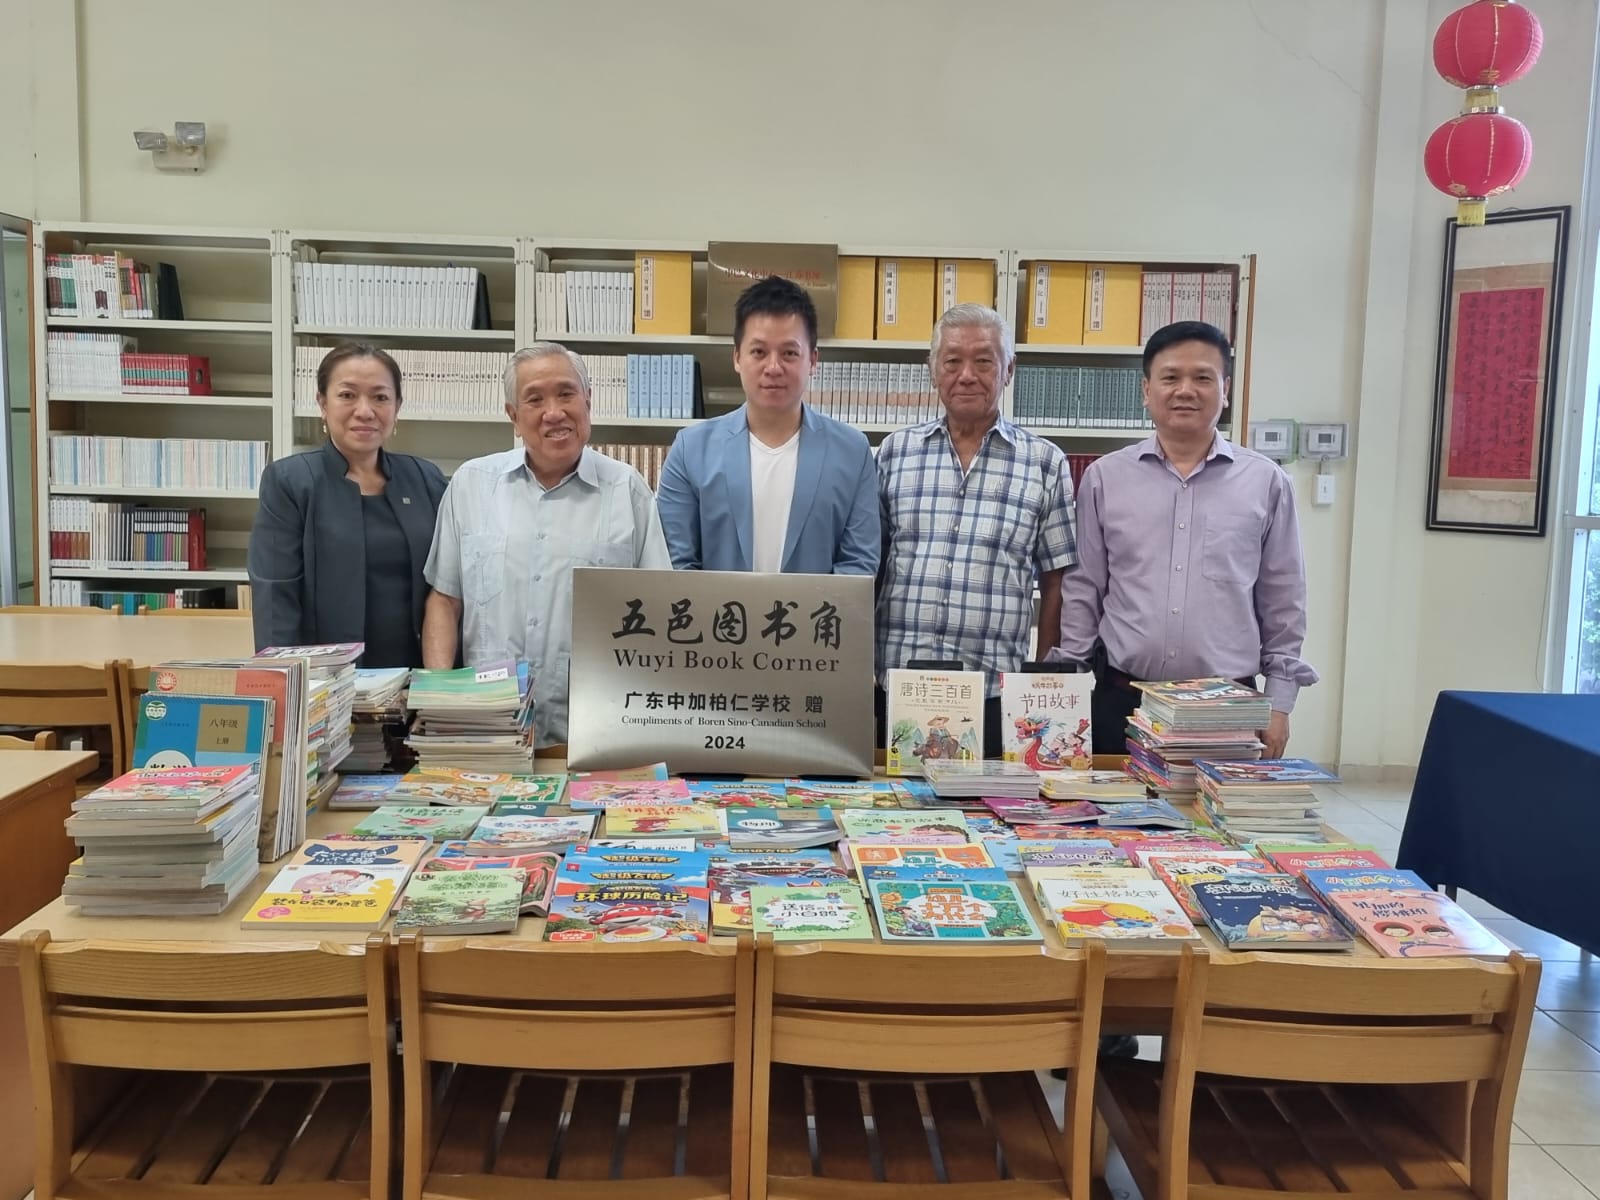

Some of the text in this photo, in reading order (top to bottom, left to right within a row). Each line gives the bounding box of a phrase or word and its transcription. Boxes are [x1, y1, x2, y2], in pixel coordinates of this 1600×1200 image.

[612, 598, 842, 650] 五邑图书角
[613, 649, 840, 672] Wuyi Book Corner
[900, 682, 972, 699] 唐诗三百首
[624, 691, 823, 713] 广东中加柏仁学校 赠
[1019, 693, 1081, 714] 节日故事
[208, 717, 239, 730] 八年级
[621, 715, 826, 729] Compliments of Boren Sino-Canadian School
[215, 735, 230, 746] 上册
[704, 736, 746, 749] 2024
[574, 891, 690, 903] 环球历险记
